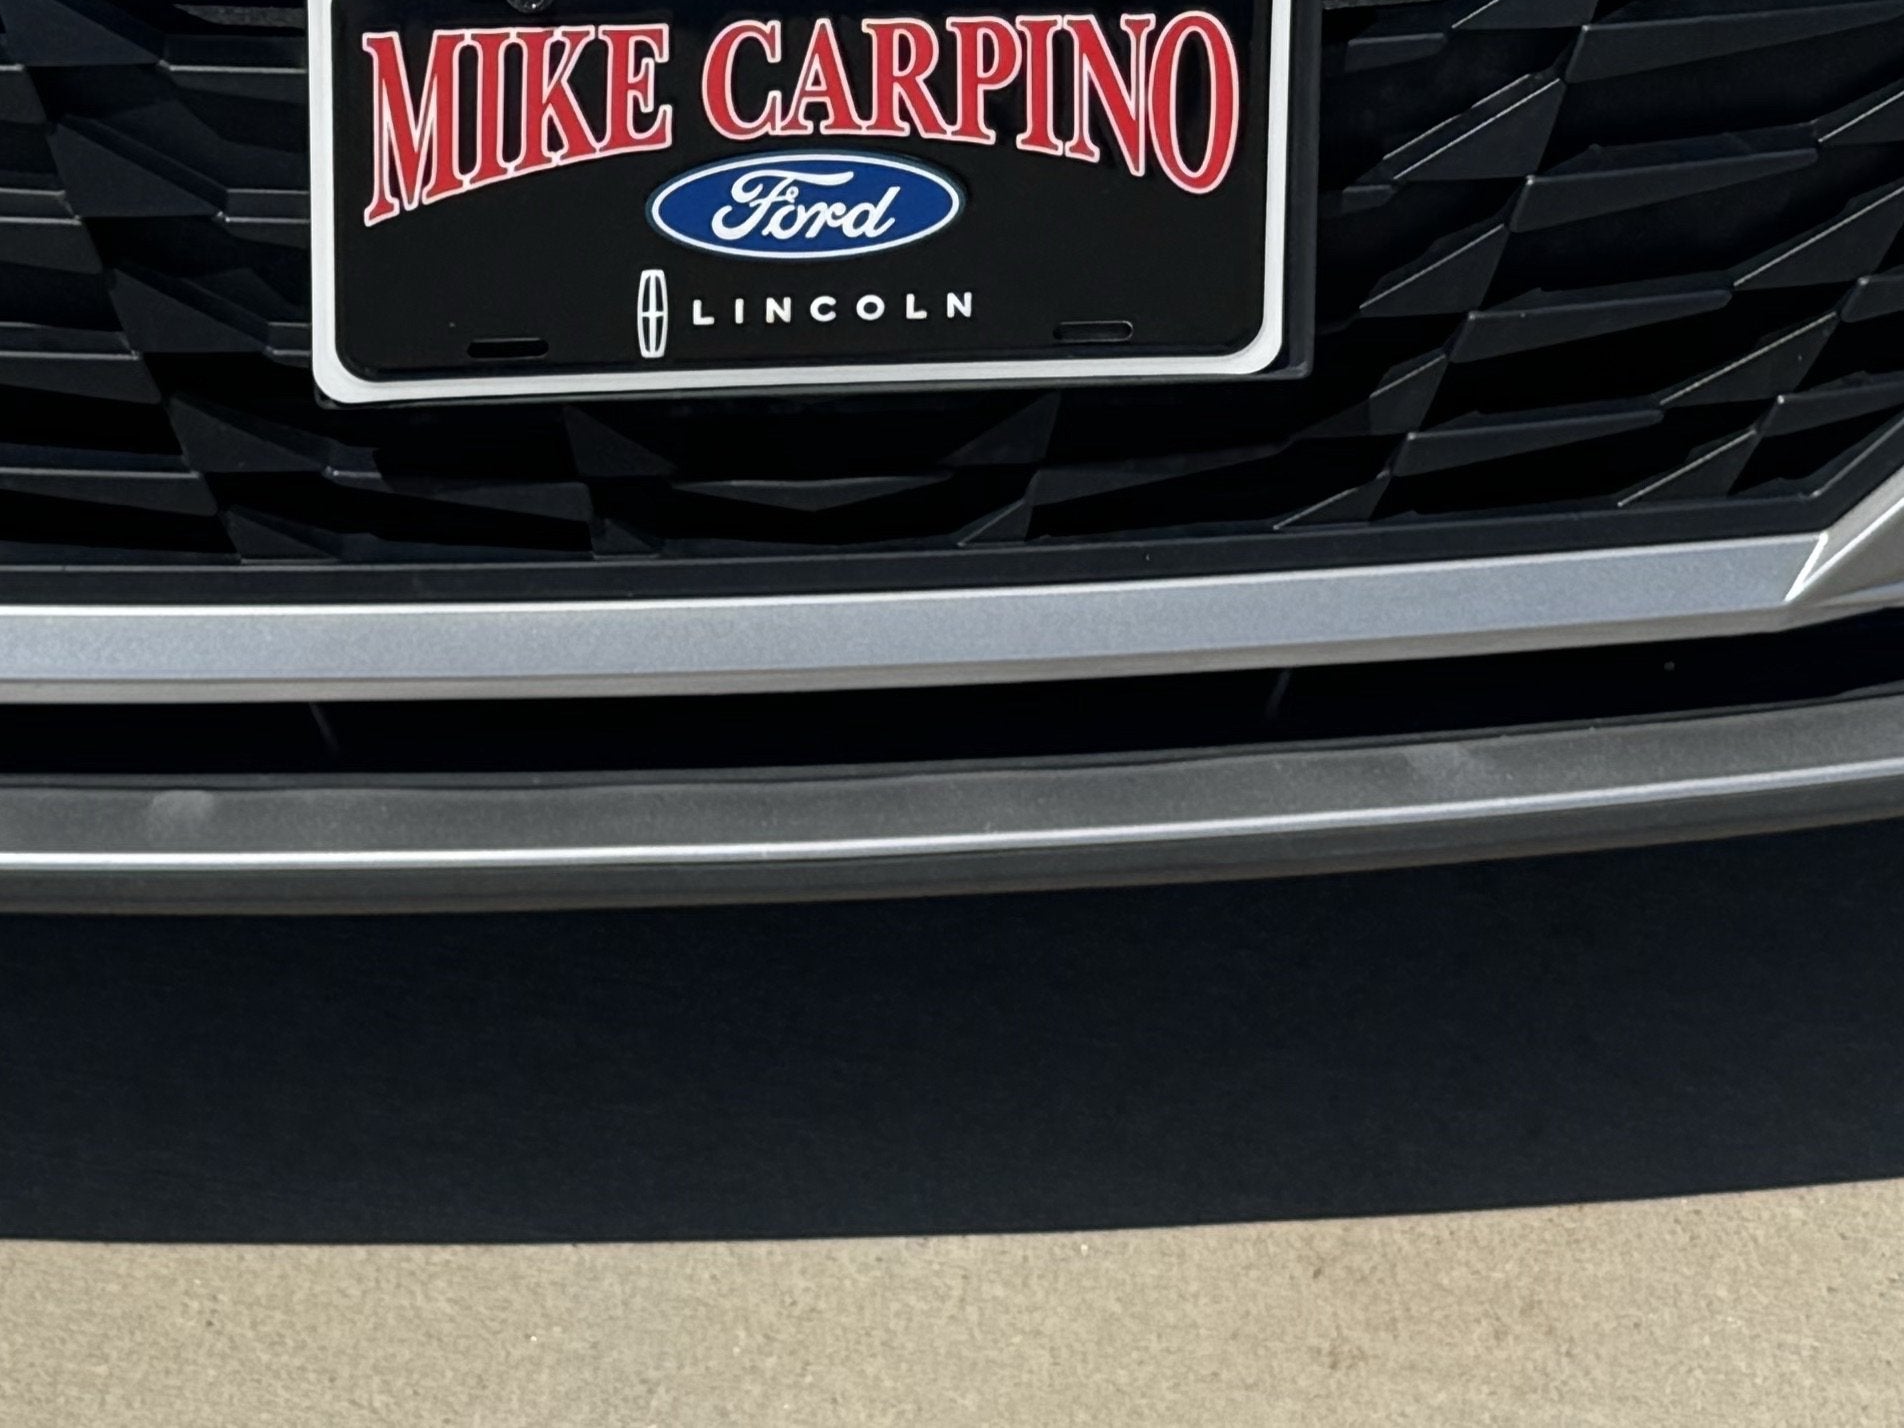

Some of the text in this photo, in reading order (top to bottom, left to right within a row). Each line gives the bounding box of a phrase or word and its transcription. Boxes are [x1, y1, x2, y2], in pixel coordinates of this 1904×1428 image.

[362, 10, 1240, 227] MIKE CARPINO
[711, 169, 901, 241] Ford
[692, 291, 973, 326] LINCOLN
